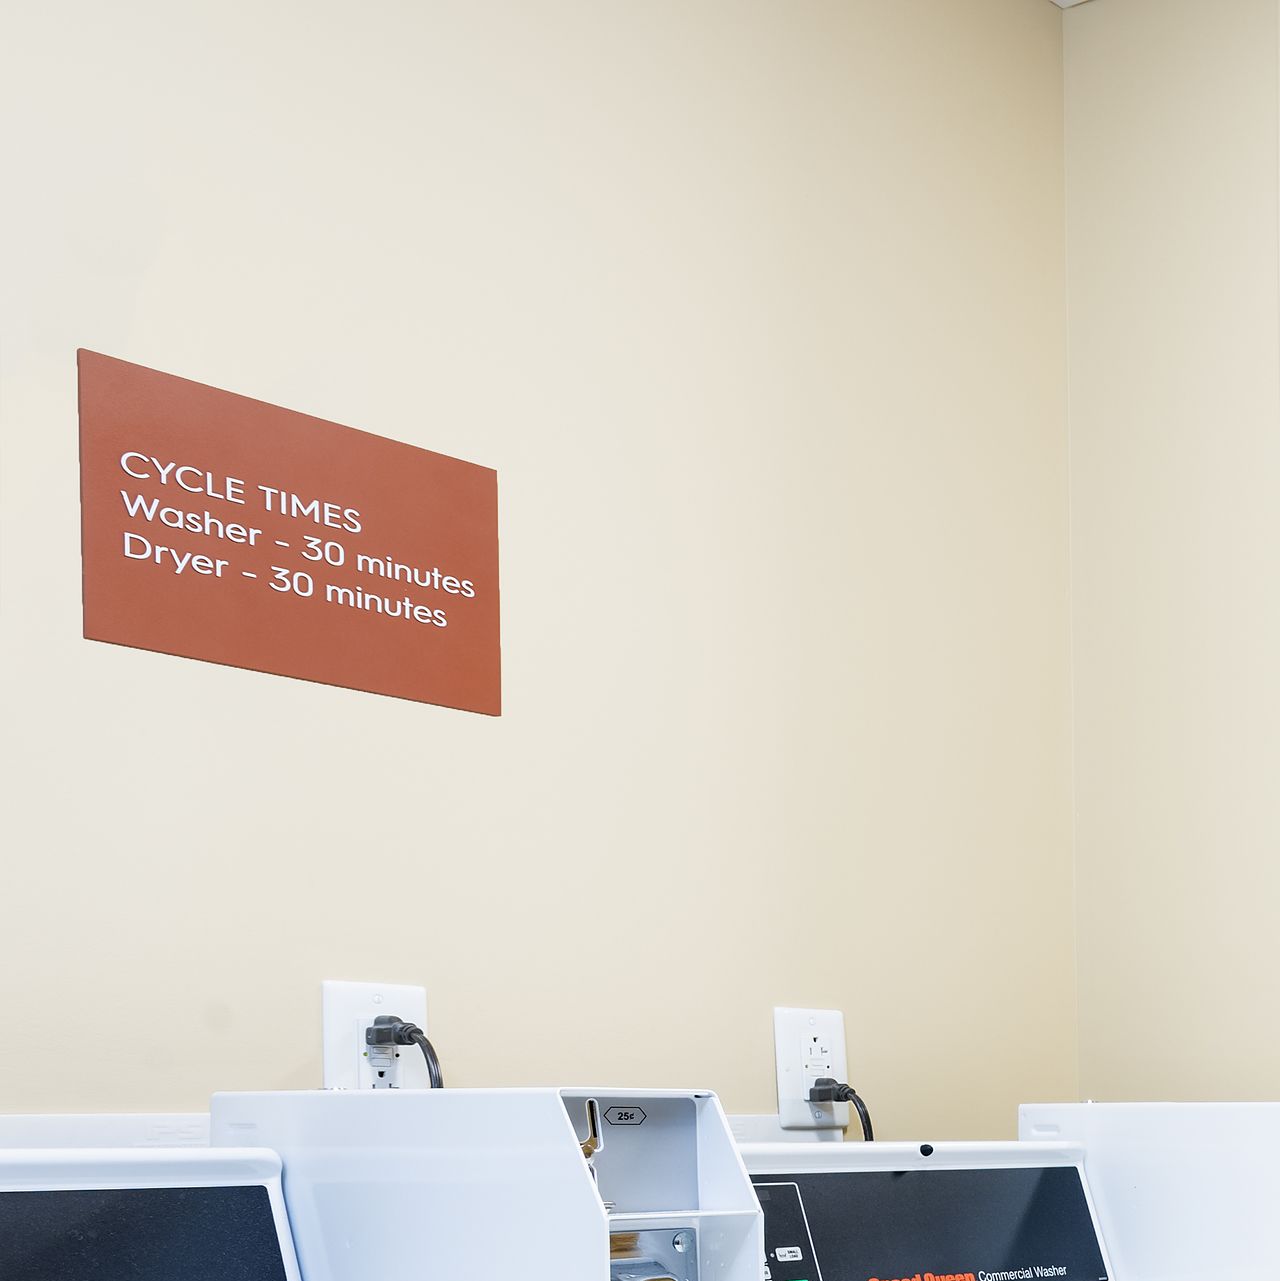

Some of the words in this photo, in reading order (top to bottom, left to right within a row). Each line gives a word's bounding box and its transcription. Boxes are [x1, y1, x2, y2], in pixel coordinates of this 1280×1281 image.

[120, 452, 246, 505] CYCLE
[257, 485, 362, 533] TIMES
[120, 490, 263, 547] Washer
[301, 535, 345, 567] 30
[356, 553, 475, 598] minutes
[123, 531, 230, 578] Dryer
[268, 565, 314, 598] 30
[325, 584, 448, 628] minutes
[1033, 1265, 1067, 1278] Washer
